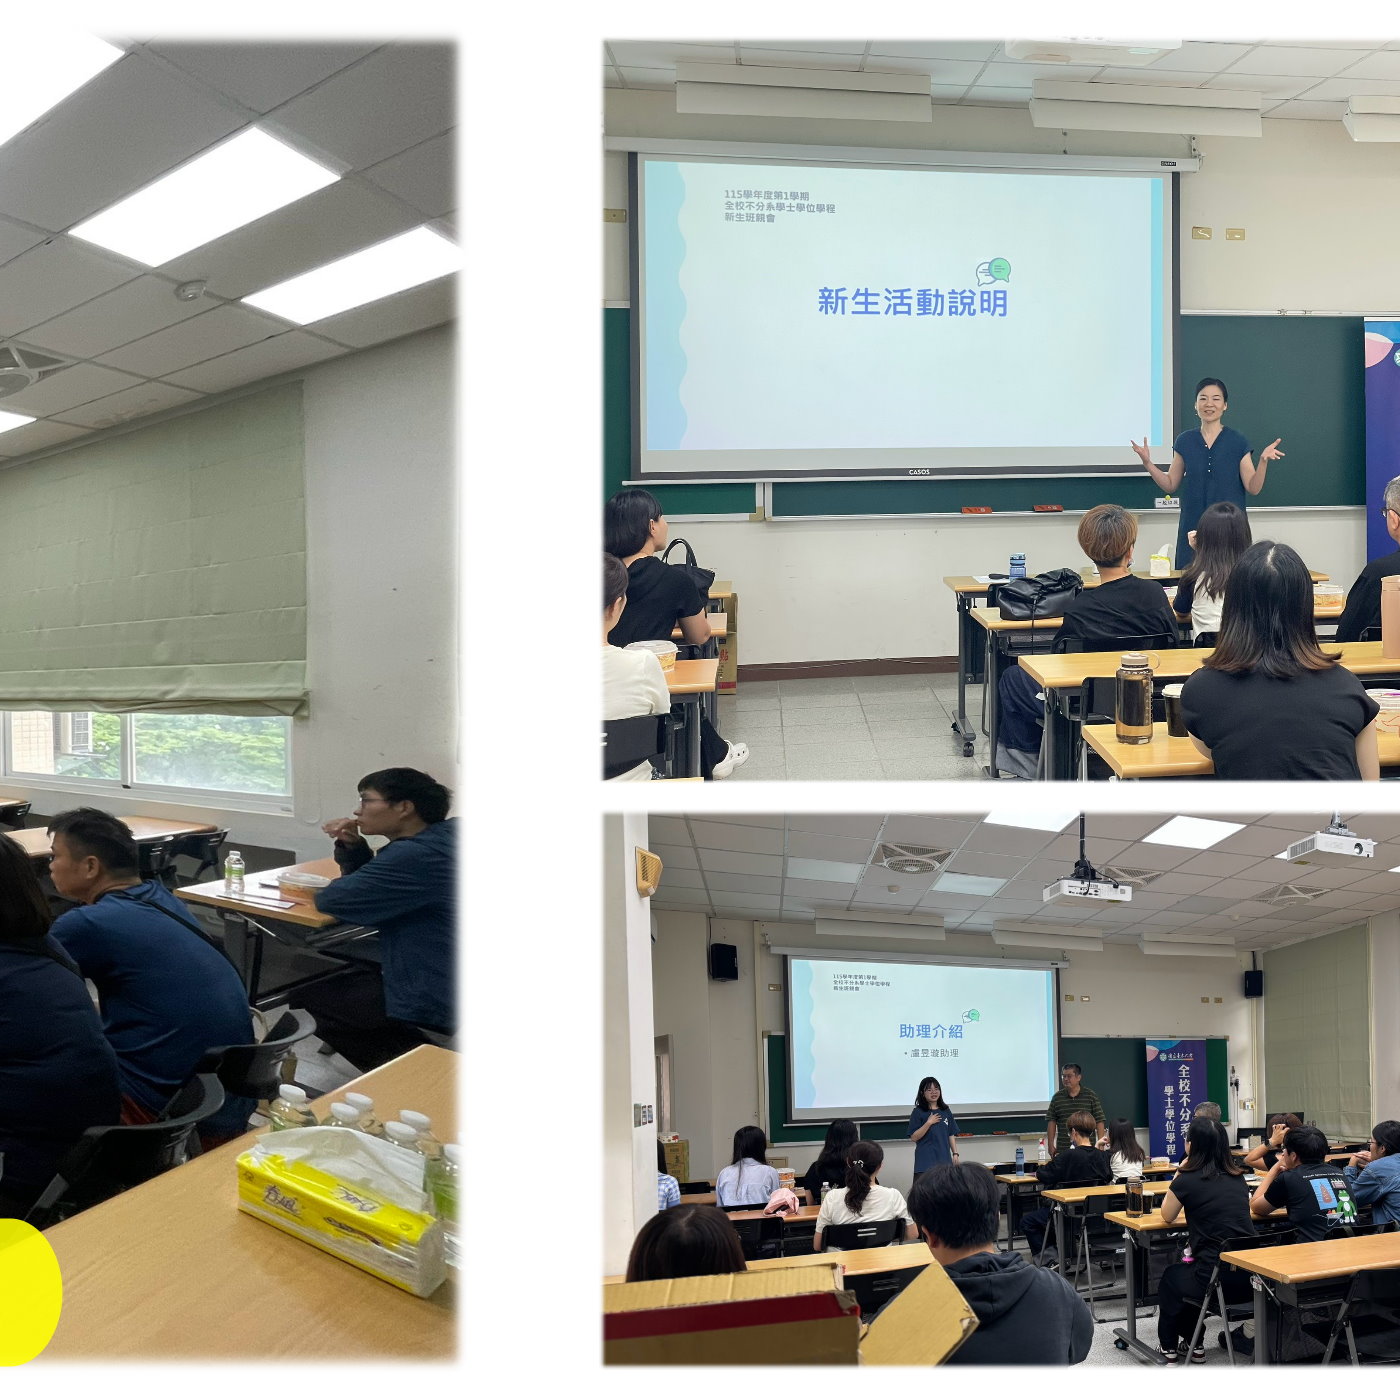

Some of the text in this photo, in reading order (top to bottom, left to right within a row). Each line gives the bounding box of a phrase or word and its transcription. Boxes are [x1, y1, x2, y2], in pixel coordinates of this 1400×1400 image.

[724, 189, 810, 201] 115學年度第1學期
[724, 201, 836, 214] 全校不分系學士學位學程
[818, 286, 1009, 319] 新生活動說明
[908, 468, 931, 476] CASOS
[899, 1023, 963, 1039] 助理介紹
[1163, 1085, 1177, 1156] 學士學位學程
